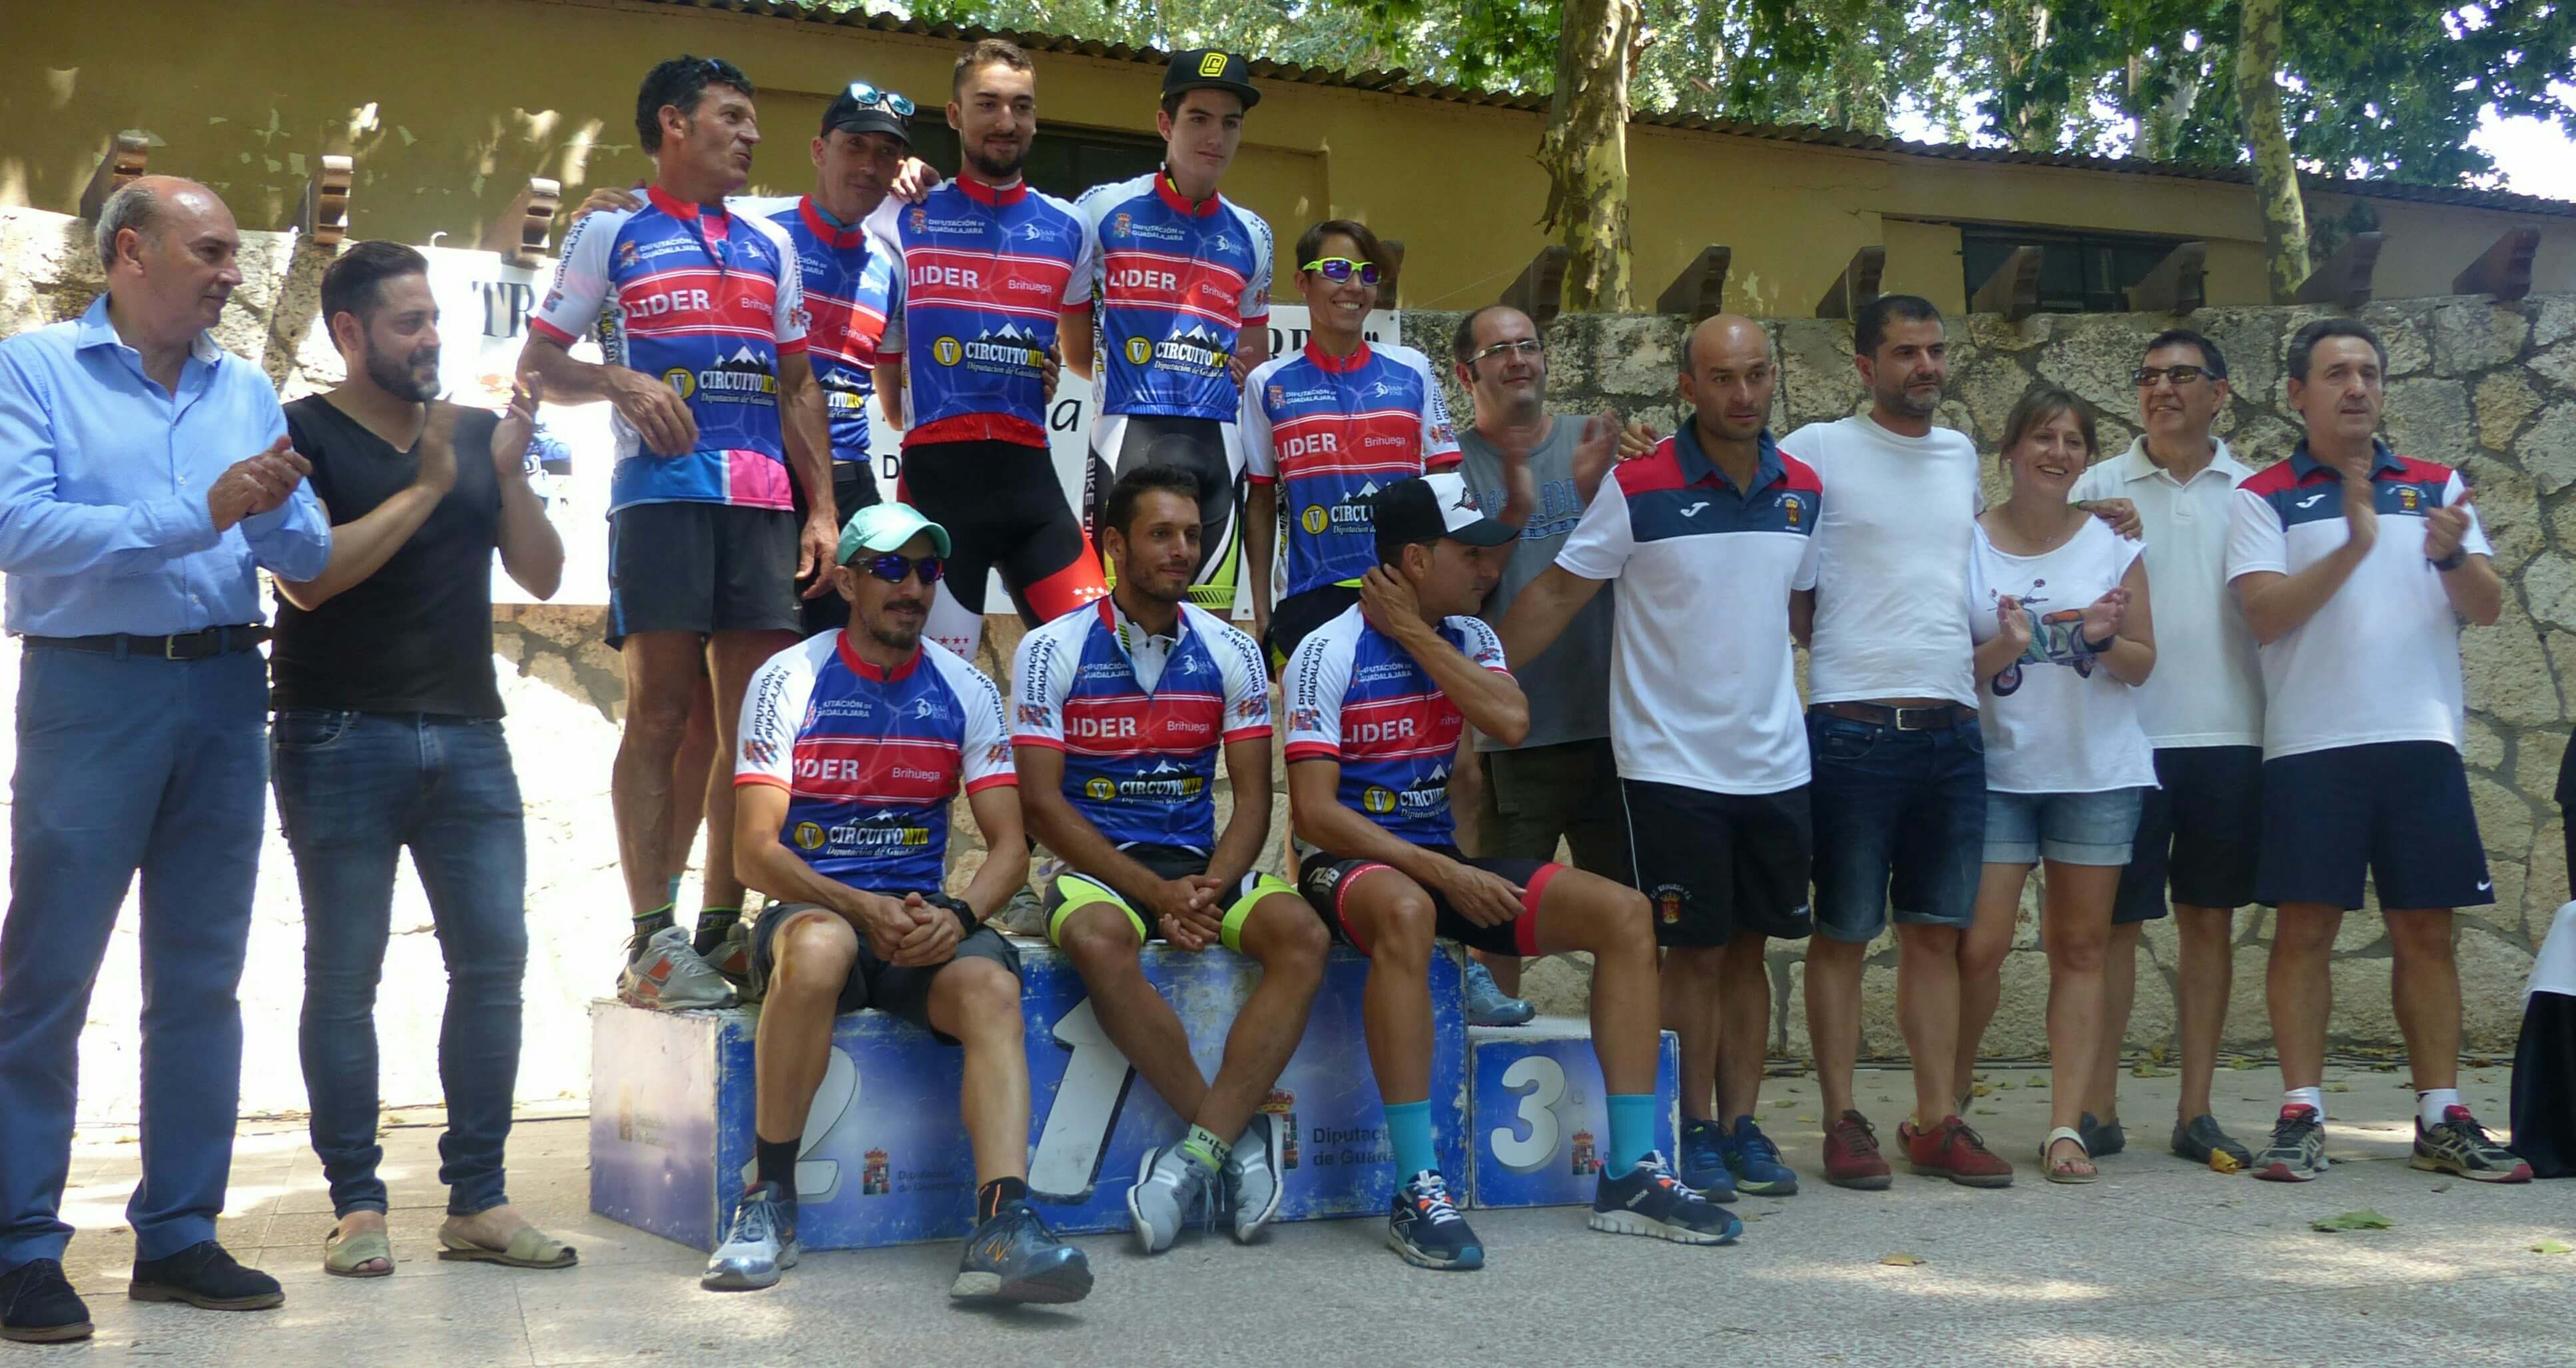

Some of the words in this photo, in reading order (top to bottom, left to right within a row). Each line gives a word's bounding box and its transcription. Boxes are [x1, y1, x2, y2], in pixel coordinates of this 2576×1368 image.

[928, 225, 984, 234] GUADALAJARA
[910, 266, 979, 289] LIDER
[1008, 280, 1052, 294] Brihuega
[1109, 269, 1177, 290] LIDER
[625, 288, 711, 318] LIDER
[1274, 433, 1338, 464] LIDER
[1365, 436, 1406, 450] Brihuega
[1086, 458, 1096, 506] BIKE
[1027, 639, 1043, 701] DIPUTACIÓN
[1038, 637, 1059, 703] GUADALAJARA
[1231, 637, 1260, 693] DIPUTACIÓN
[1298, 643, 1315, 705] DIPUTACIÓN
[1308, 639, 1331, 706] GUADALAJARA
[754, 671, 775, 736] DIPUTACIÓN
[765, 669, 792, 739] GUADALAJARA
[1167, 720, 1210, 733] Brihuega
[892, 767, 941, 783] Brihuega
[1490, 1054, 1566, 1175] 3
[1313, 1128, 1387, 1146] Diputaci
